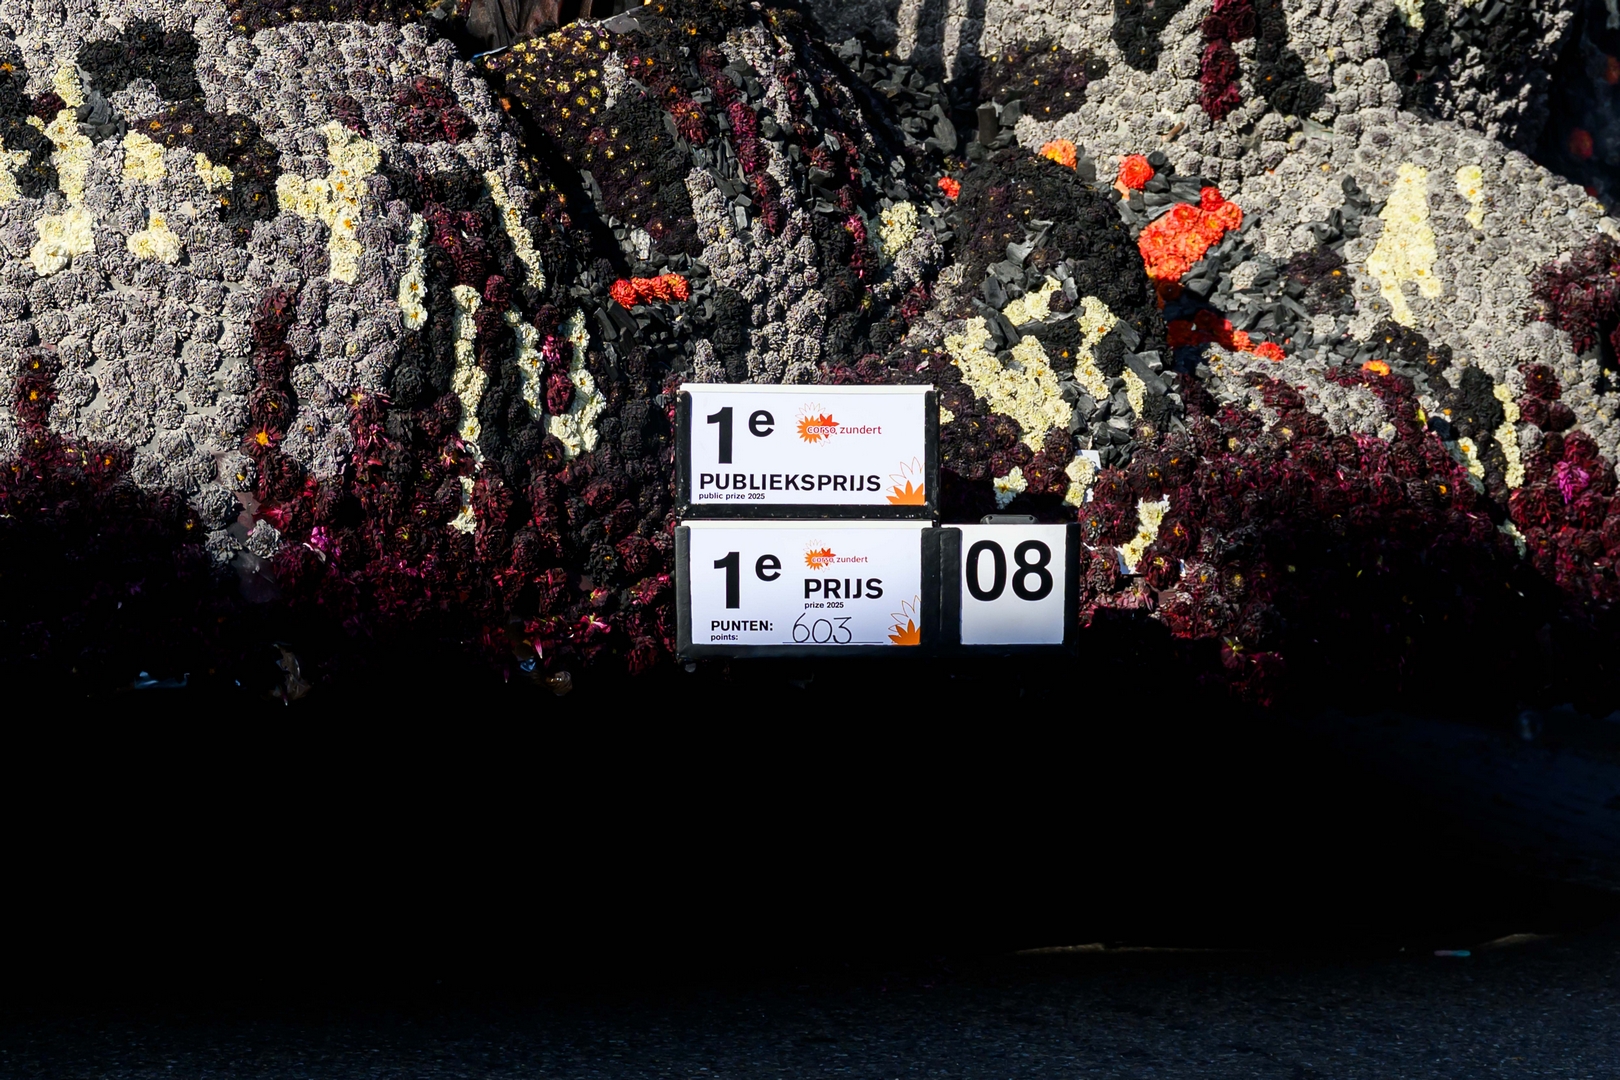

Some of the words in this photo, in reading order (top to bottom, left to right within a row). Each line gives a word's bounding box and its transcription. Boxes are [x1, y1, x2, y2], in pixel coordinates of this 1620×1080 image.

[707, 407, 775, 465] 1e
[807, 425, 836, 435] corso
[839, 424, 882, 435] zundert
[699, 473, 881, 492] PUBLIEKSPRIJS
[699, 492, 723, 501] public
[726, 493, 746, 501] prize
[836, 555, 868, 563] zundert
[966, 540, 1054, 602] 08
[714, 552, 782, 610] 1e
[805, 578, 884, 600] PRIJS
[805, 601, 825, 610] prize
[827, 601, 845, 609] 2025
[711, 619, 774, 632] PUNTEN:
[792, 612, 853, 644] 603
[711, 633, 739, 643] points:
